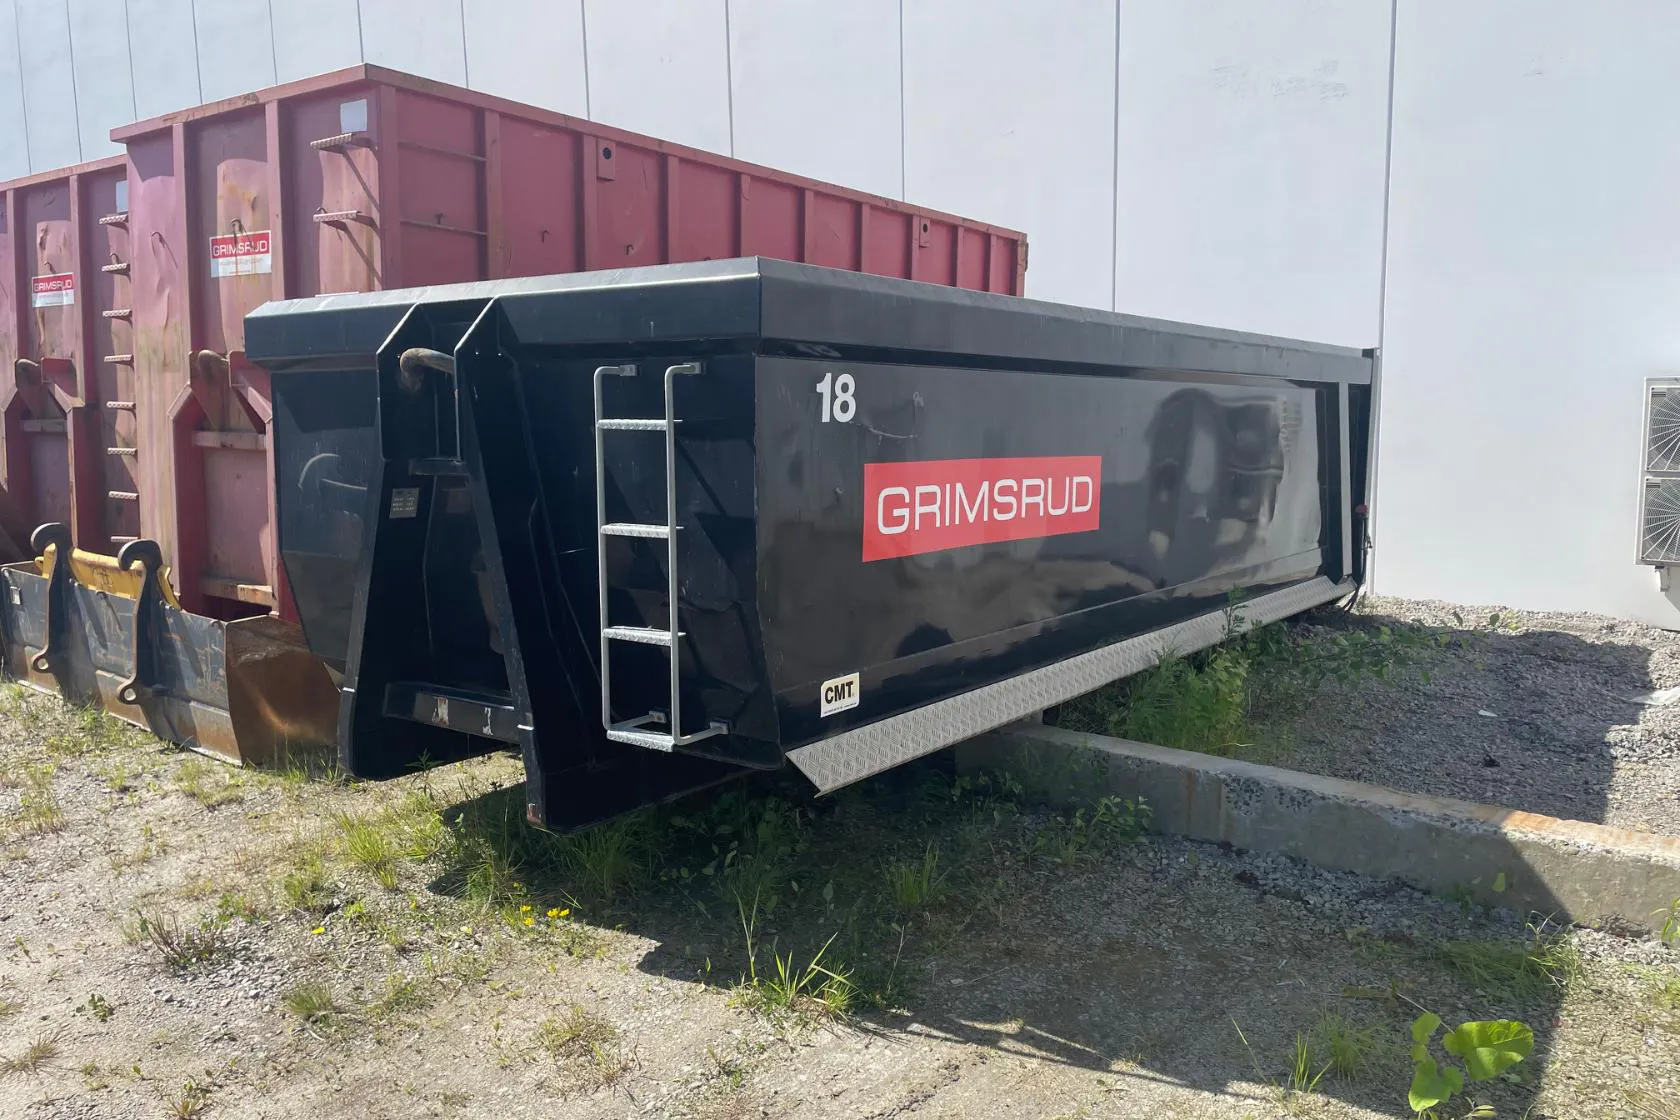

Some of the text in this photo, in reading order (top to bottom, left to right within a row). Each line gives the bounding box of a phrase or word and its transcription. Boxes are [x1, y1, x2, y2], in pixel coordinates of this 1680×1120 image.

[815, 372, 857, 423] 18
[876, 475, 1093, 535] GRIMSRUD
[824, 680, 855, 705] CMT
